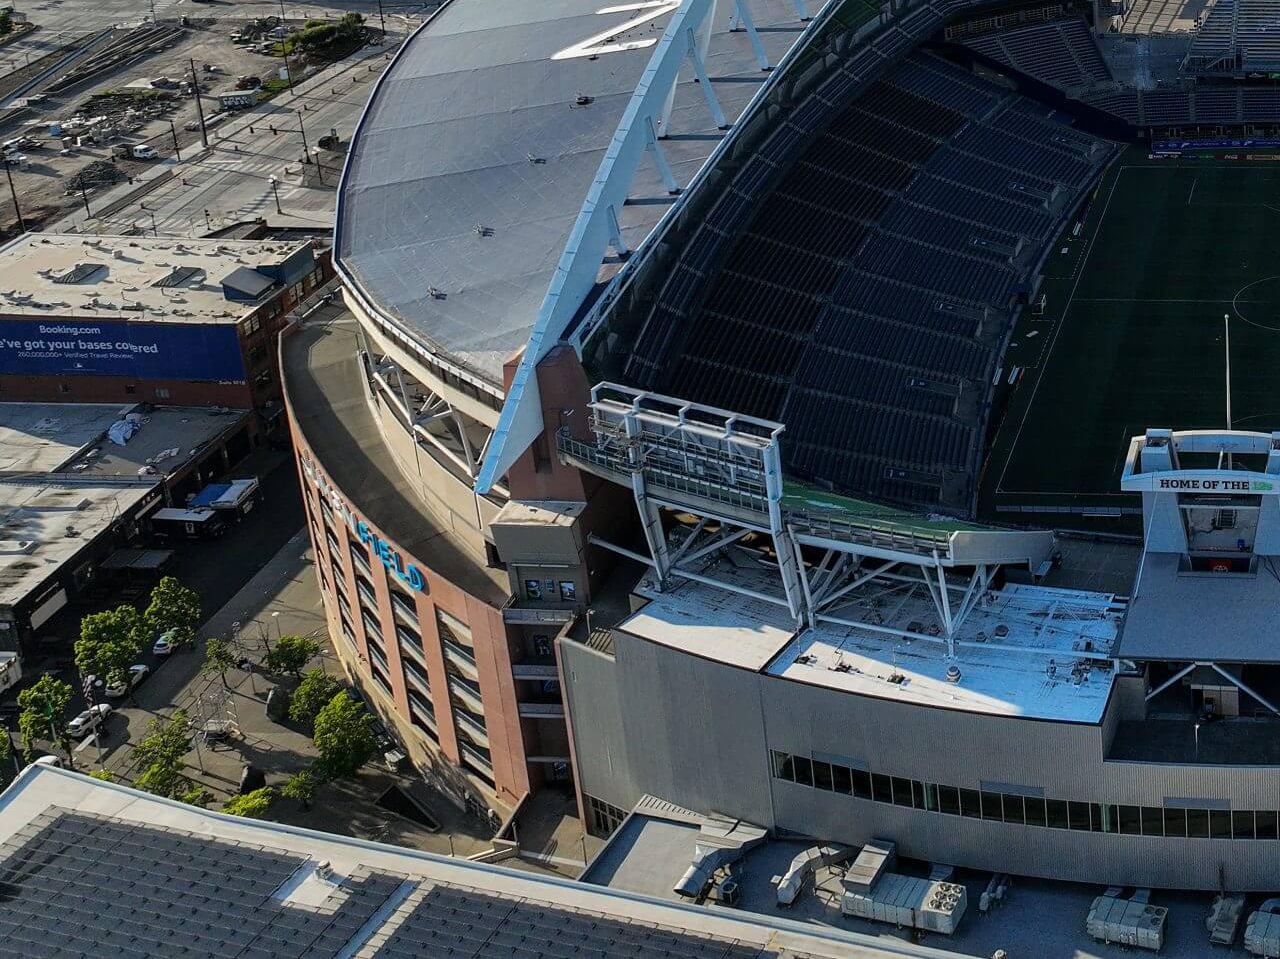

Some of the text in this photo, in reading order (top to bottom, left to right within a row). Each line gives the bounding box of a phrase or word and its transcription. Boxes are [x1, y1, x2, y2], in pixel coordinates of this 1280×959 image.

[39, 325, 101, 336] Booking.com
[24, 340, 46, 351] got
[47, 342, 76, 351] your
[79, 340, 113, 350] bases
[115, 342, 159, 353] covered
[1159, 479, 1200, 490] HOME
[1202, 480, 1220, 490] OF
[1221, 480, 1250, 490] THE
[357, 520, 427, 593] FIELD
